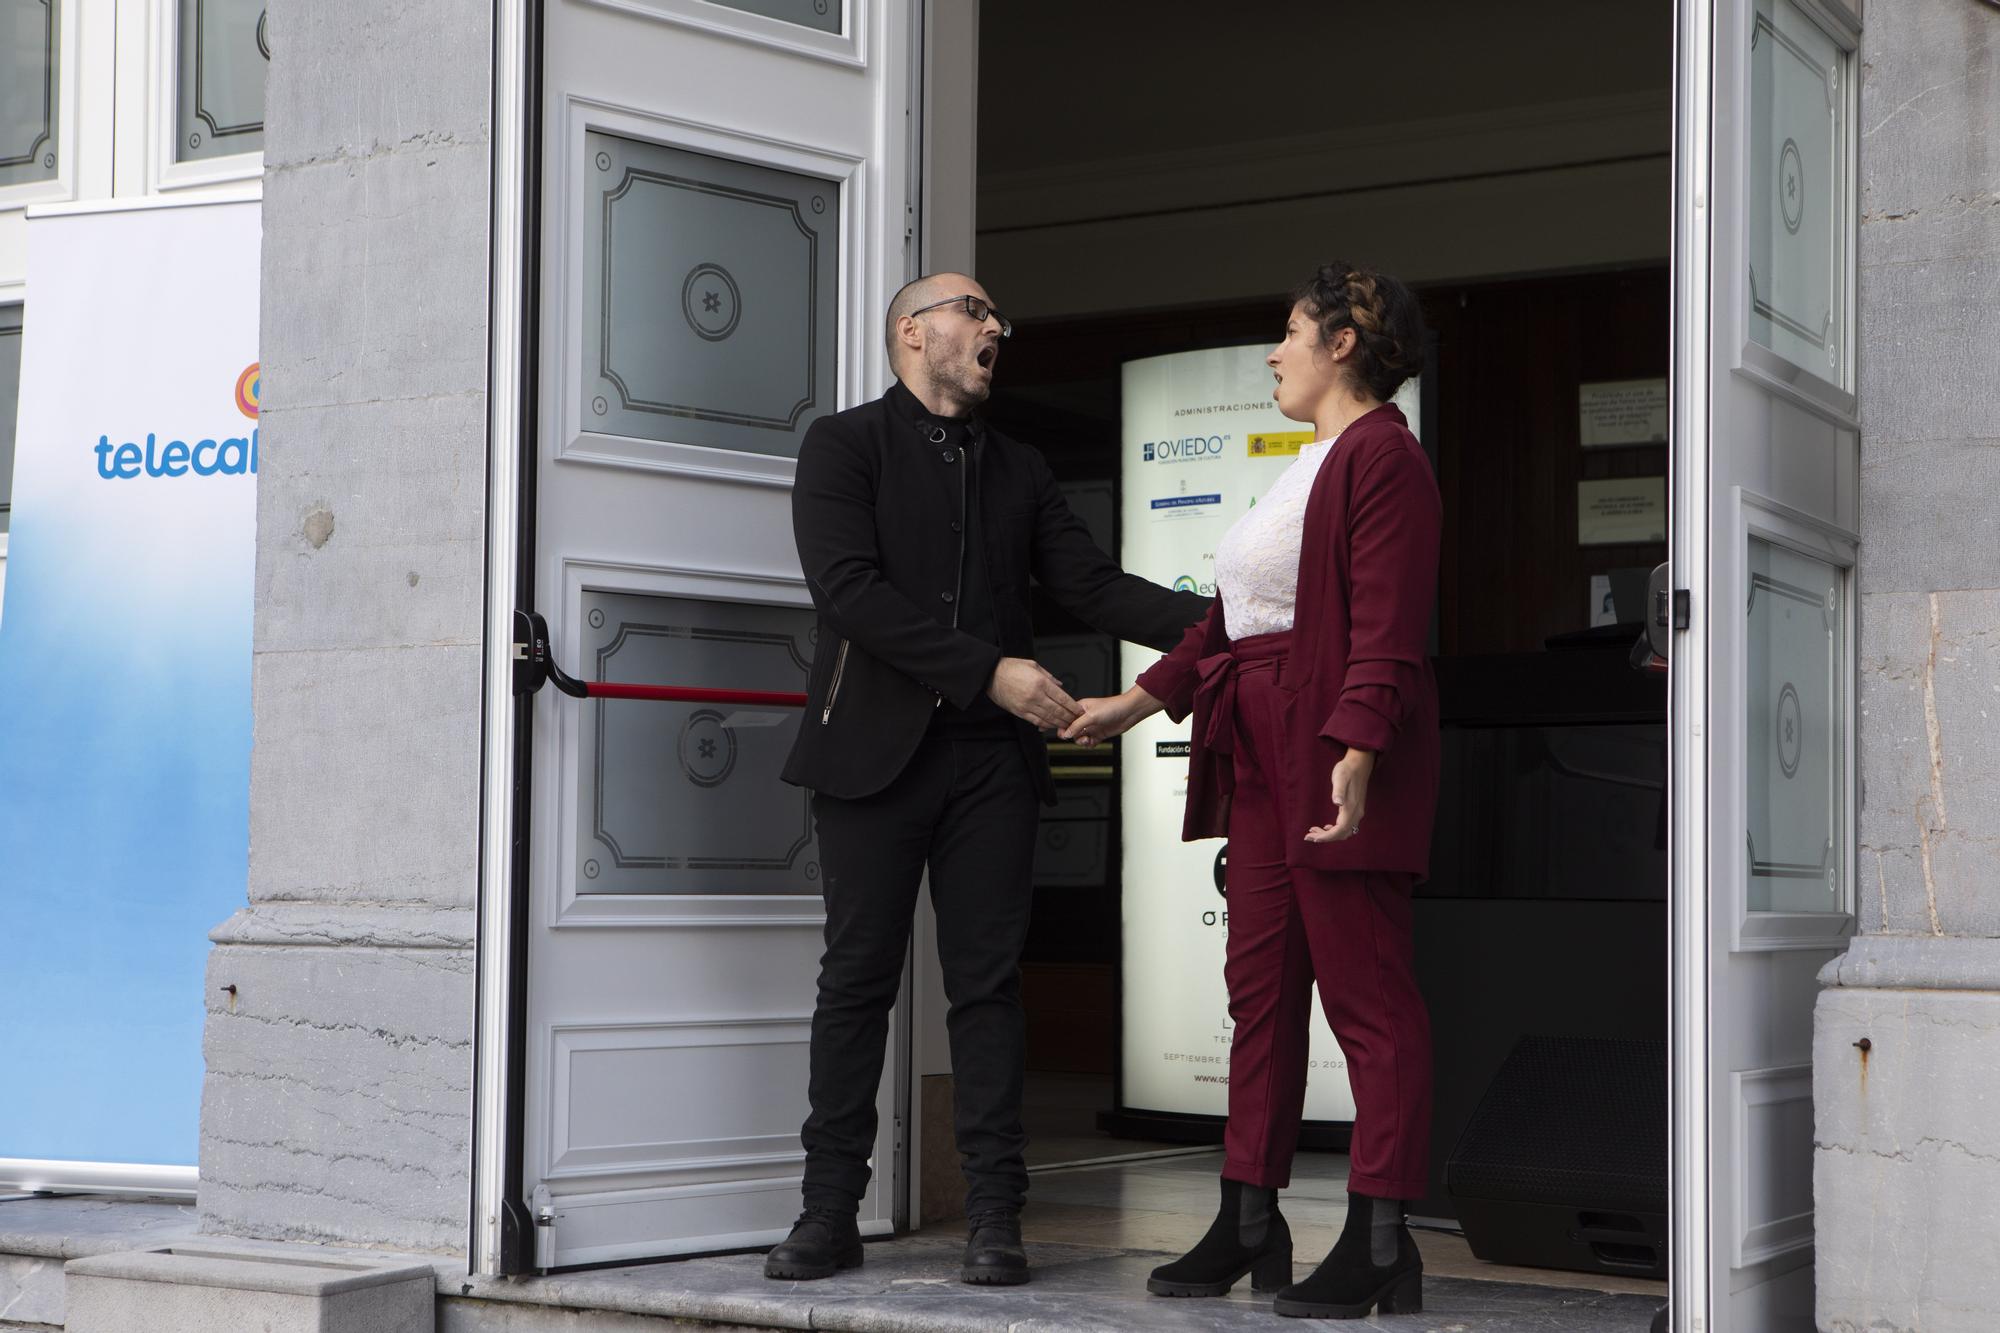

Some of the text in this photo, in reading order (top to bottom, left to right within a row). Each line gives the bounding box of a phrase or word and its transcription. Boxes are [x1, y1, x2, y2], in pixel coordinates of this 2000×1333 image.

[1174, 401, 1273, 417] ADMINISTRACIONES
[1158, 745, 1184, 753] Fundación
[1163, 1053, 1221, 1064] SEPTIEMBRE
